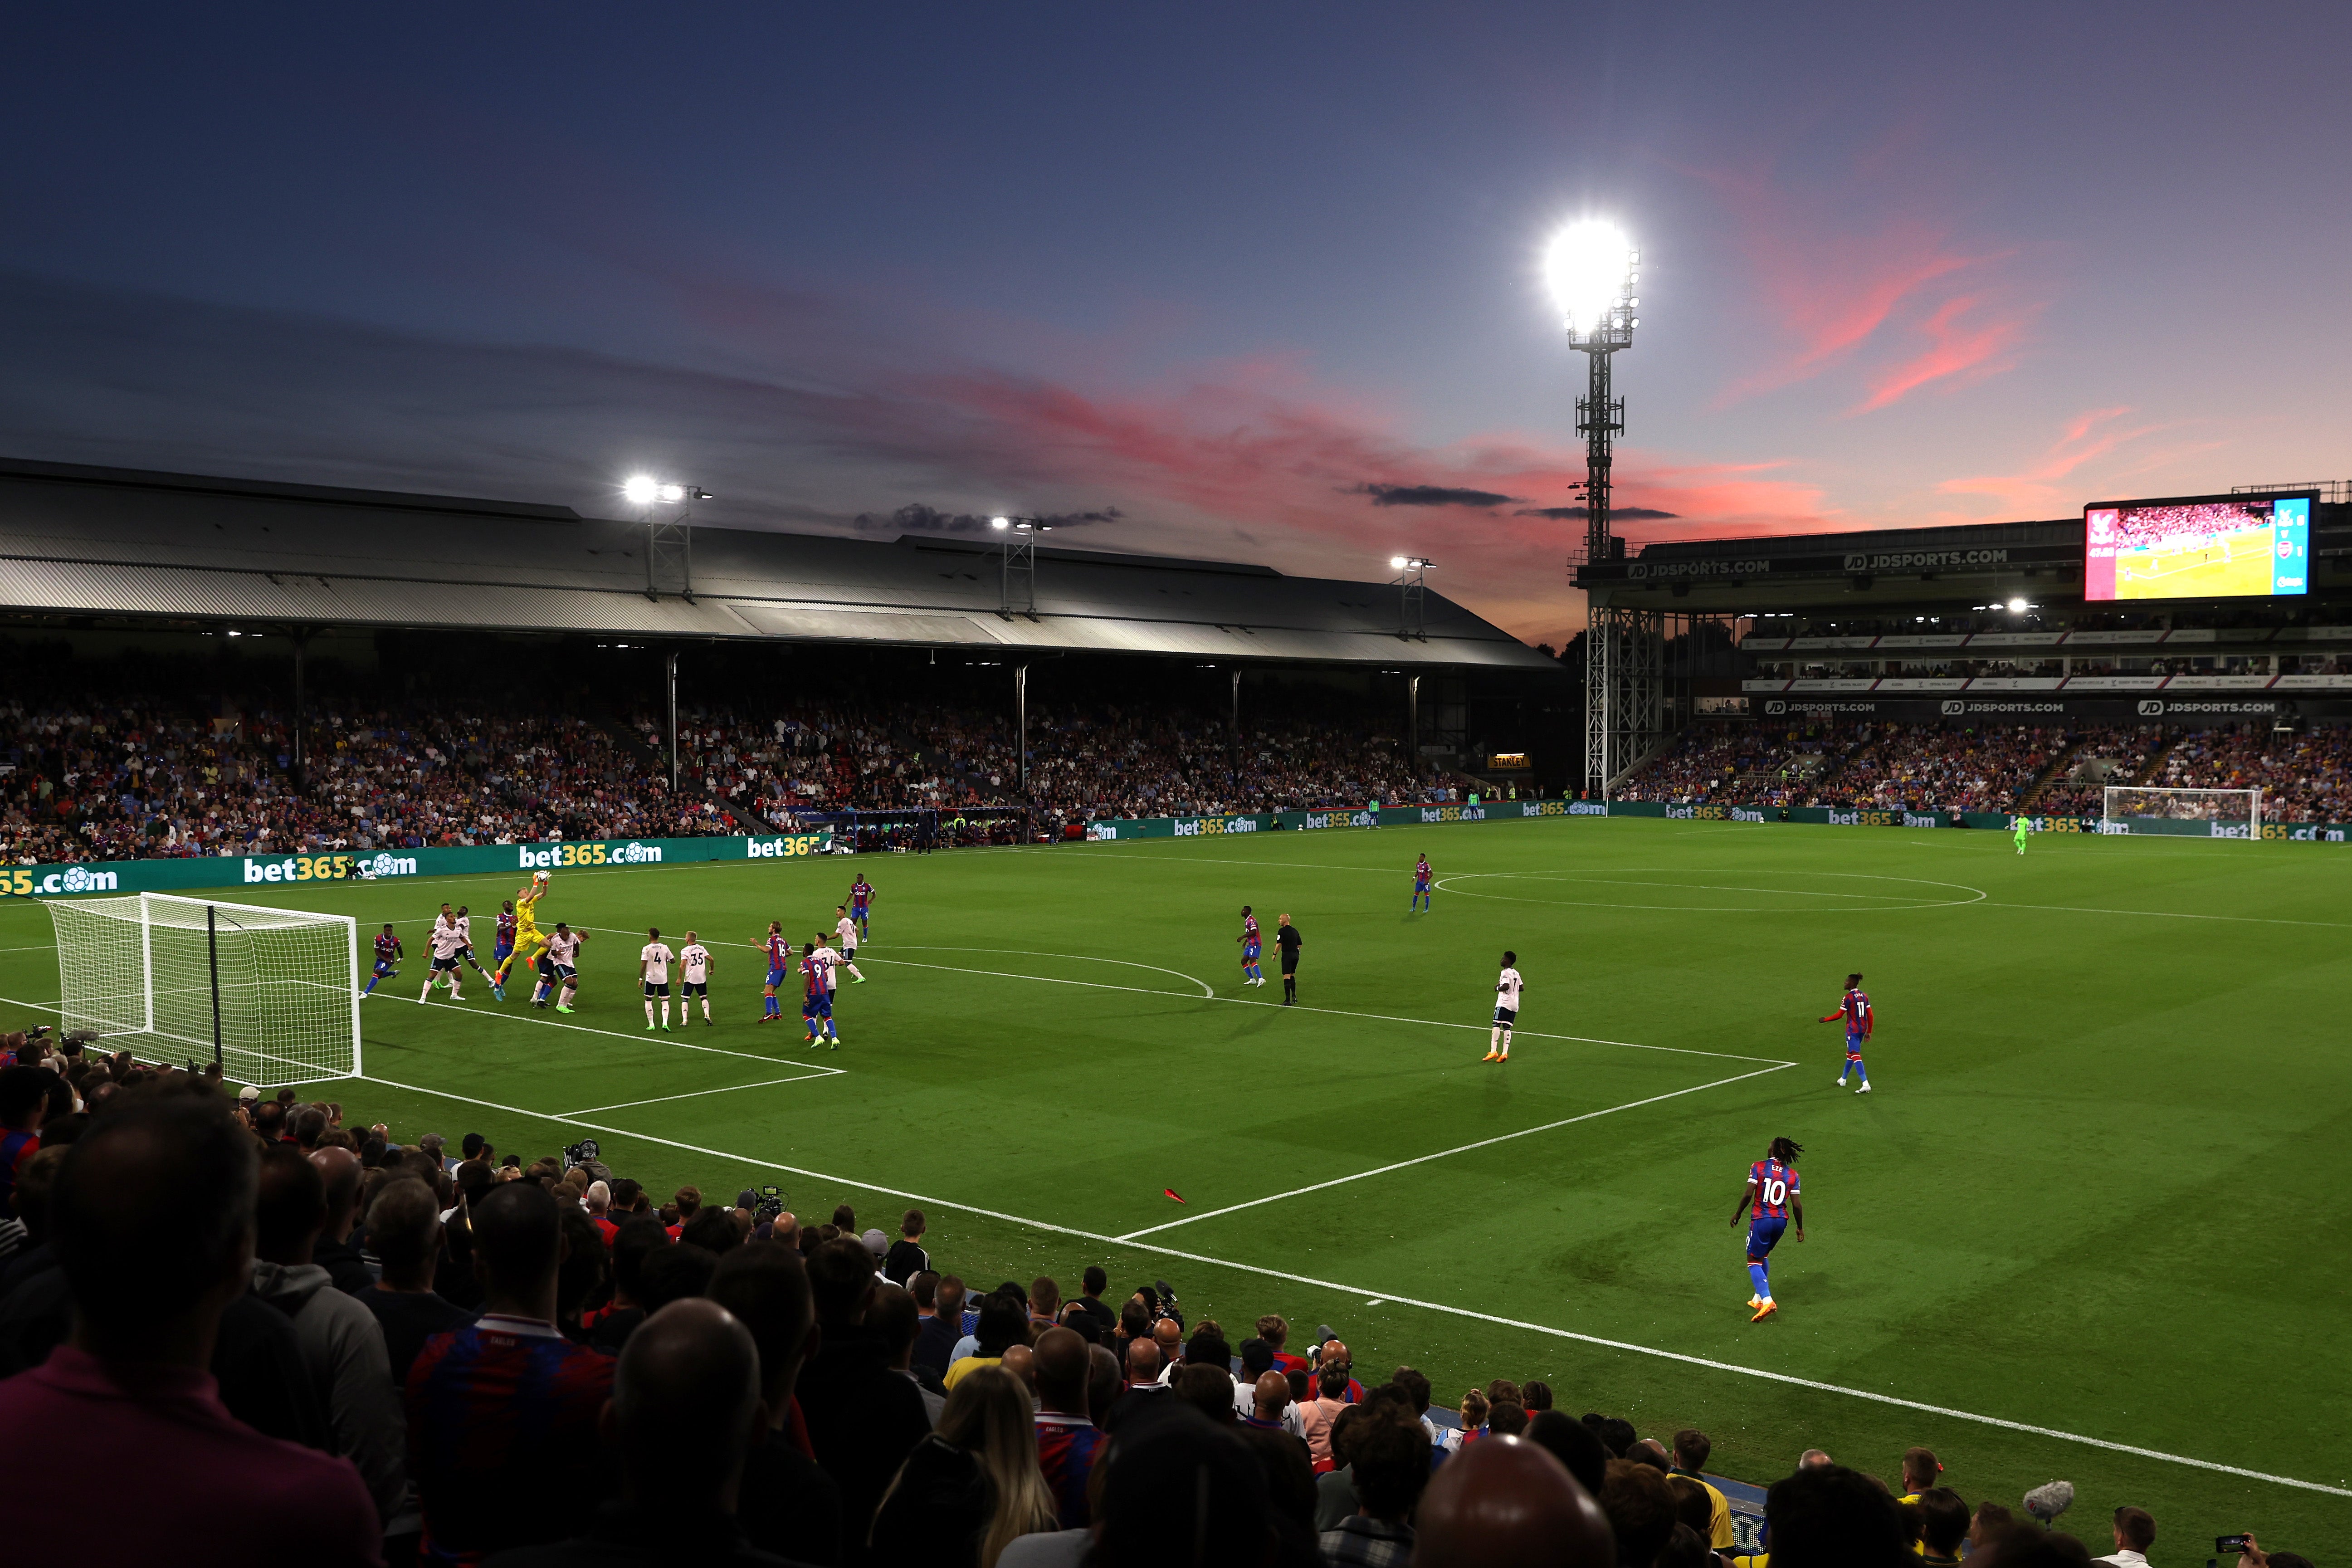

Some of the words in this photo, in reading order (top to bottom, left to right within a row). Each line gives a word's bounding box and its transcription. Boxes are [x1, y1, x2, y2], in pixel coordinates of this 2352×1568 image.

[1869, 550, 2007, 568] JDSPORTS.COM
[1650, 561, 1769, 577] JDSPORTS.COM
[1789, 703, 1875, 712] JDSPORTS.COM
[1967, 703, 2063, 712] JDSPORTS.COM
[2167, 703, 2275, 713] JDSPORTS.COM
[1493, 757, 1524, 767] STANLEY
[1666, 804, 1762, 821] bet365om
[1829, 810, 1935, 827] bet365om
[1174, 817, 1256, 836] bet365.com
[519, 841, 662, 868] bet365.com
[244, 853, 416, 882] bet365com
[778, 943, 786, 957] 16
[654, 952, 661, 964] 4
[691, 953, 703, 966] 35
[822, 956, 835, 970] 34
[814, 964, 822, 978] 9
[1513, 978, 1517, 992] 7
[1857, 1001, 1864, 1017] 11
[1763, 1177, 1786, 1205] 10
